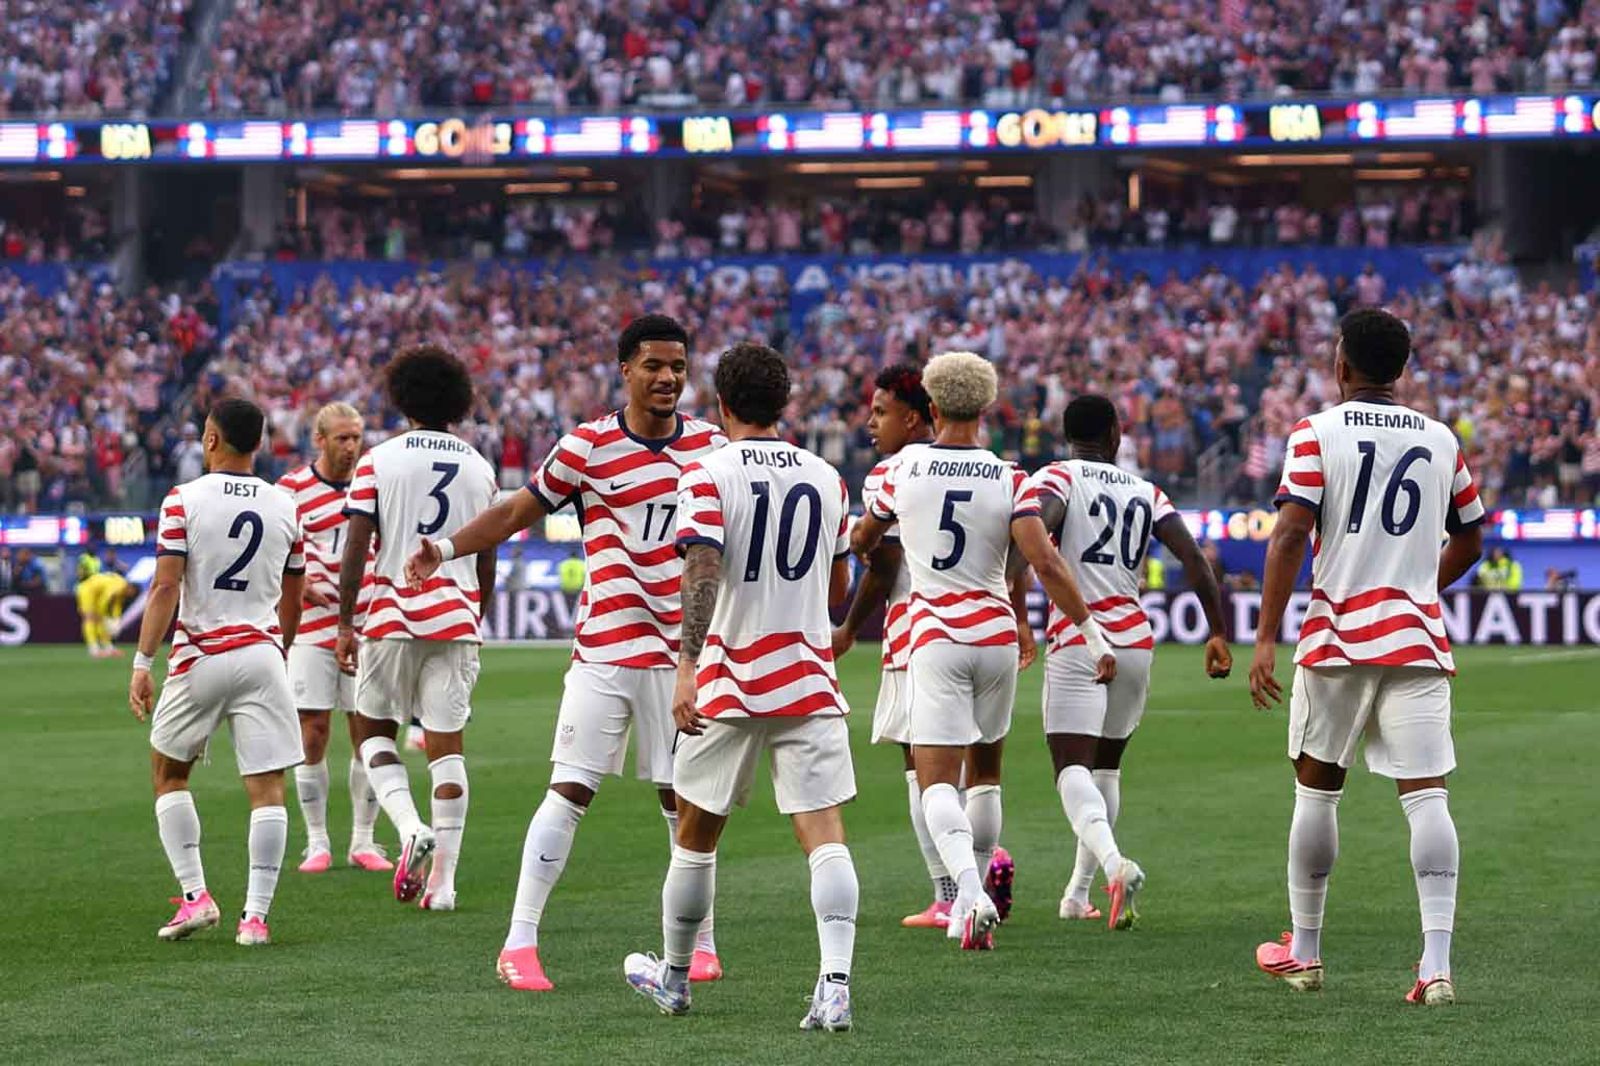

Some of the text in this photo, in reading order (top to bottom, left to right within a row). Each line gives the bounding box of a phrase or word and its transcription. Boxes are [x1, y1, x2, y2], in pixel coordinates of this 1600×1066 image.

[1344, 410, 1425, 431] FREEMAN
[223, 481, 259, 498] DEST
[741, 449, 803, 469] PULISIC
[927, 460, 1004, 480] ROBINSON
[1346, 440, 1433, 536] 16
[416, 461, 460, 536] 3
[642, 502, 678, 542] 17
[743, 480, 823, 583] 10
[931, 489, 974, 572] 5
[1080, 492, 1153, 571] 20
[212, 509, 264, 592] 2
